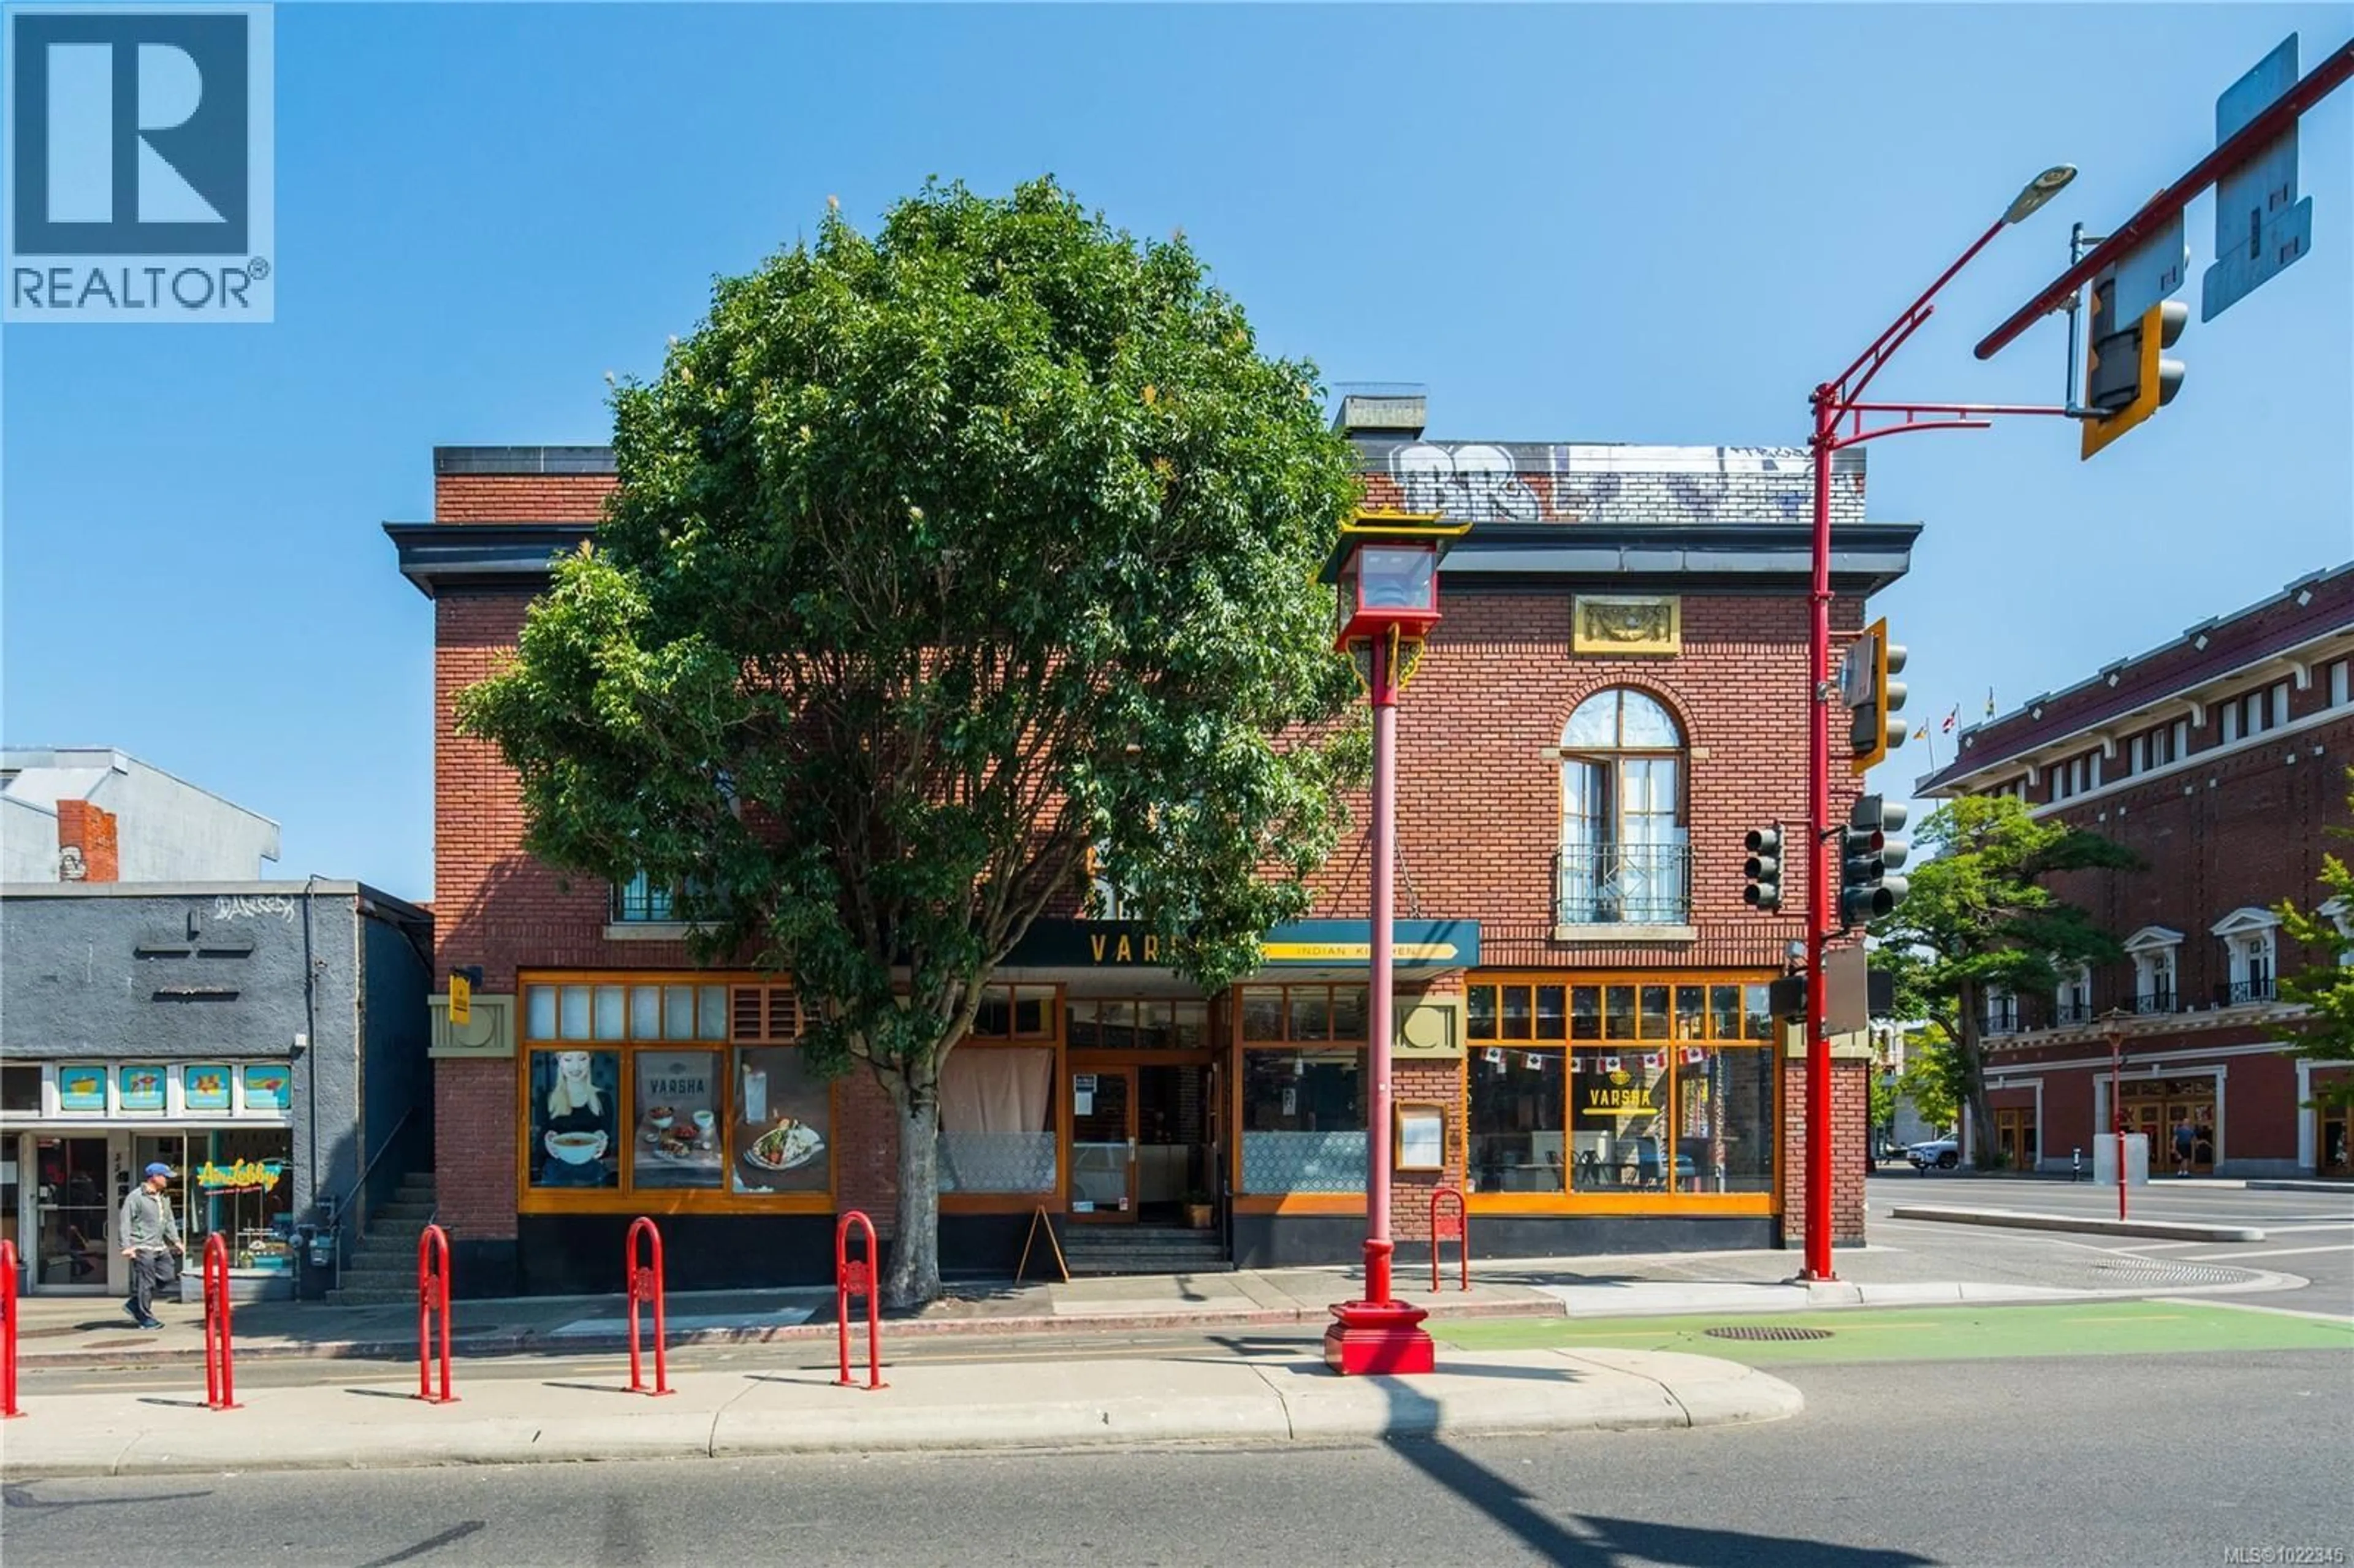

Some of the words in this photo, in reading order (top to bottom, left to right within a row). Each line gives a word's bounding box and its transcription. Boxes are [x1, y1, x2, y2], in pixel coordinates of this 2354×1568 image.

[1297, 946, 1346, 956] INDIAN
[1355, 946, 1420, 956] KIEN
[650, 1079, 704, 1094] VARSHA
[1590, 1088, 1650, 1106] VARSHA
